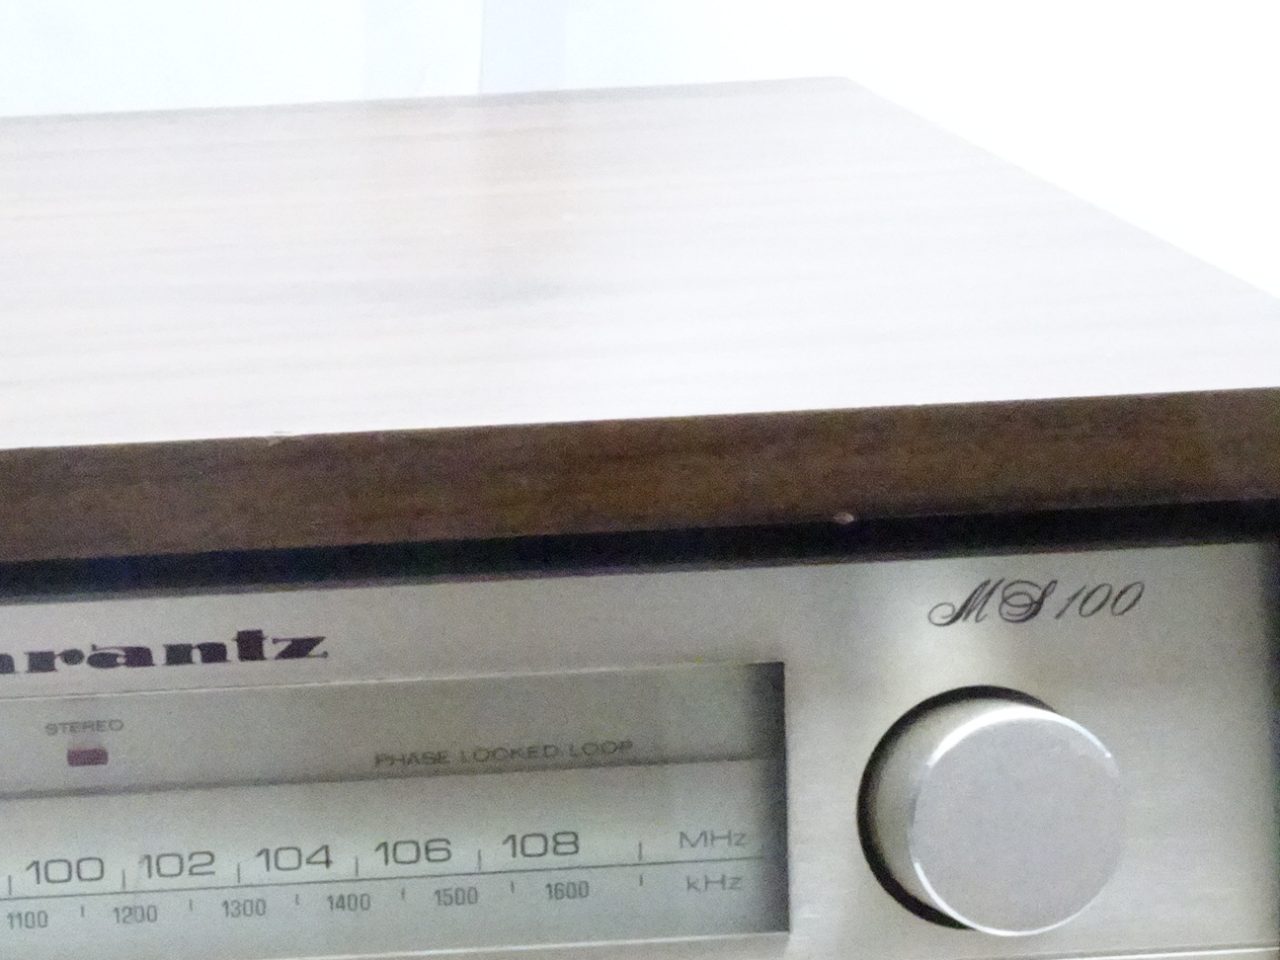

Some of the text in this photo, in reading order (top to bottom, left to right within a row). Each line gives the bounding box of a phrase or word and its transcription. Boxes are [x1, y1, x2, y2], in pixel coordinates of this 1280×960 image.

[1055, 580, 1145, 619] 100
[45, 718, 125, 737] STEREO
[374, 739, 633, 767] PHASE LOCKED LOOP
[24, 857, 106, 884] 100
[137, 851, 216, 878] 102
[254, 845, 334, 874] 104
[374, 836, 453, 867] 106
[501, 829, 581, 859] 108
[678, 827, 749, 852] MHz
[5, 910, 49, 932] 1100
[112, 903, 159, 926] 1200
[220, 896, 267, 920] 1300
[326, 891, 372, 915] 1400
[432, 884, 480, 909] 1500
[544, 878, 591, 903] 1600
[685, 871, 744, 895] kHz
